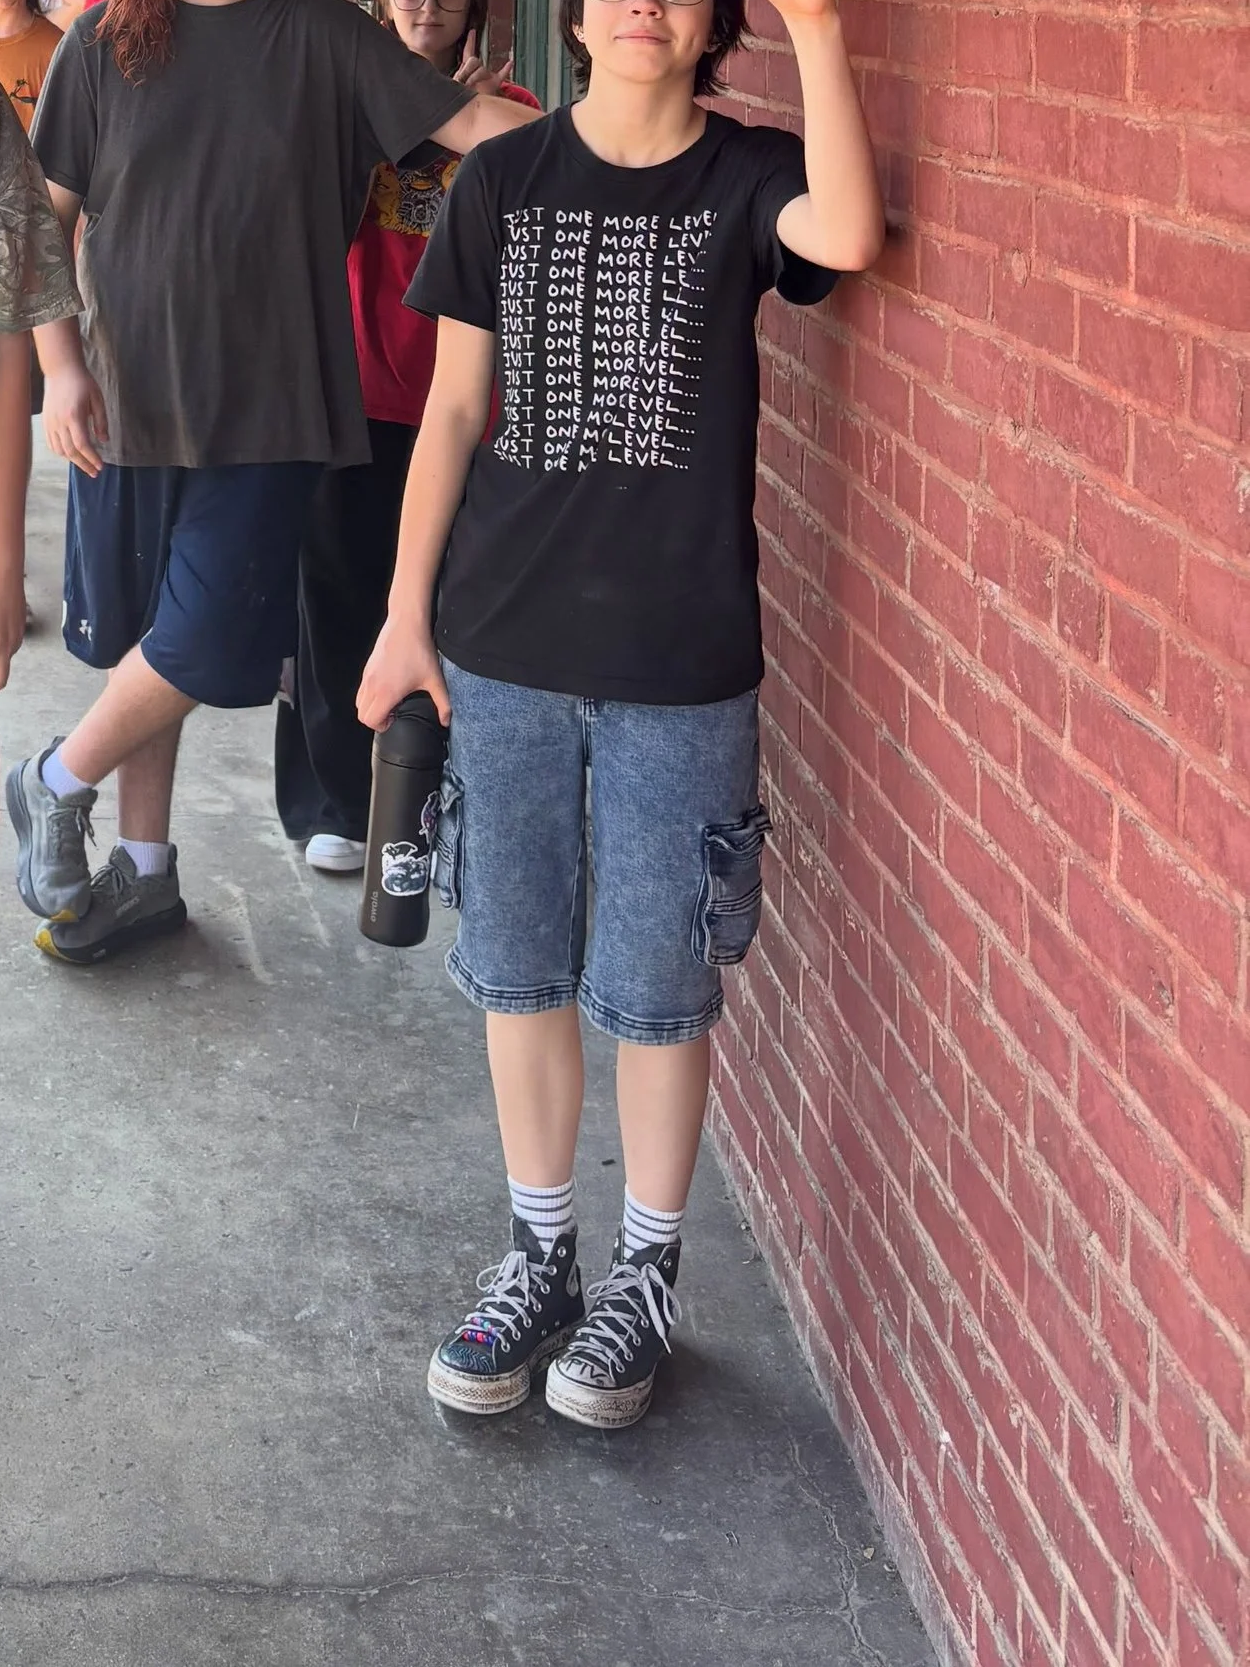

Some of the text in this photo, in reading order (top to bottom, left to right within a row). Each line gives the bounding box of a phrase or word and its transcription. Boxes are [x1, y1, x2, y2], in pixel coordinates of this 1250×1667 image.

[556, 210, 593, 227] ONE
[603, 215, 659, 231] MORE
[555, 229, 592, 245] ONE
[602, 232, 658, 250] MORE
[551, 246, 587, 263] ONE
[598, 252, 654, 268] MORE
[500, 262, 540, 281] JUST
[549, 265, 586, 281] ONE
[596, 270, 653, 287] MORE
[500, 280, 538, 297] JUST
[548, 282, 586, 299] ONE
[596, 287, 651, 304] MORE
[501, 298, 536, 315] JUST
[547, 300, 584, 317] ONE
[595, 304, 650, 321] MORE
[502, 315, 537, 333] JUST
[547, 317, 584, 334] ONE
[595, 321, 651, 339] MORE
[502, 333, 534, 350] JUST
[545, 335, 582, 352] ONE
[592, 339, 648, 355] MORE
[503, 351, 535, 367] JUST
[547, 353, 582, 369] ONE
[546, 371, 582, 386] ONE
[547, 389, 583, 404] ONE
[546, 406, 582, 422] ONE
